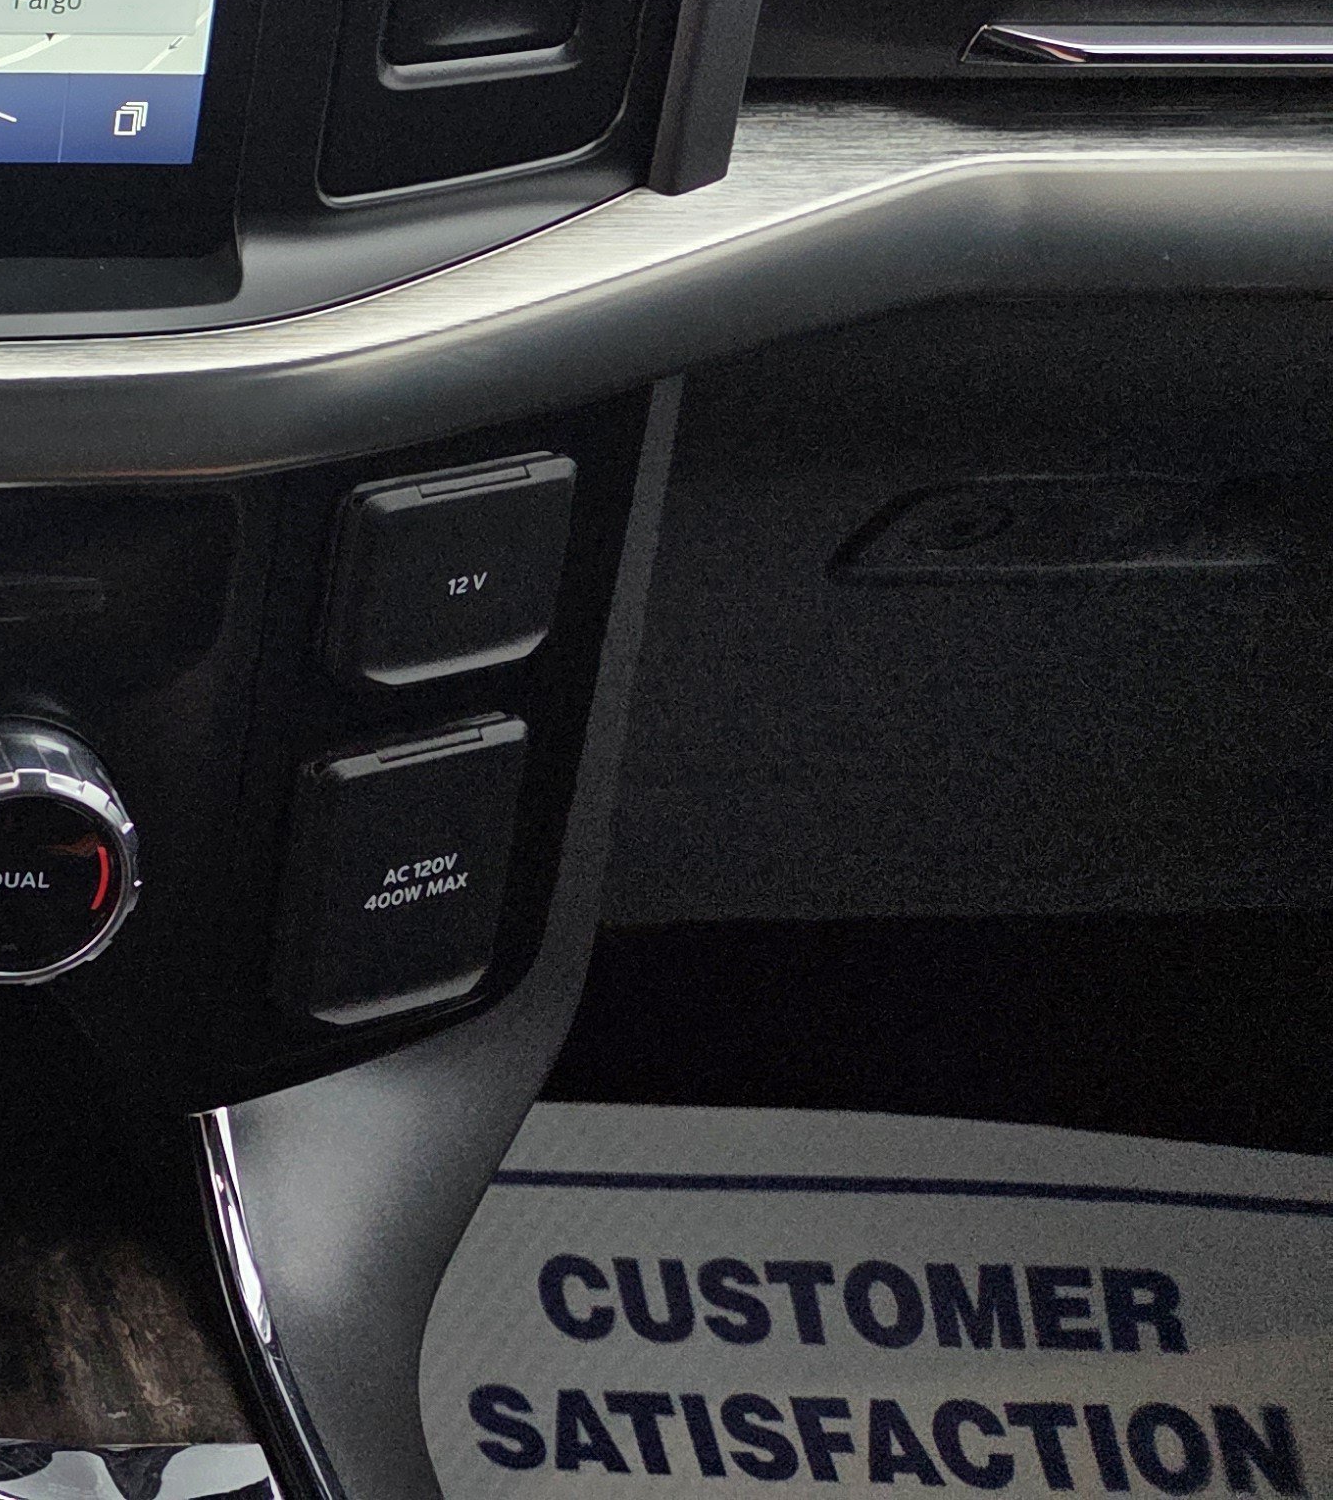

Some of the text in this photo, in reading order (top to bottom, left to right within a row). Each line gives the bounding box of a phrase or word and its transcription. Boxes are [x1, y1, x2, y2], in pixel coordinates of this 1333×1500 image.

[448, 572, 487, 596] 12 V
[383, 853, 458, 886] AC 120V
[364, 873, 468, 912] 400W MAX
[537, 1253, 1190, 1355] CUSTOMER
[467, 1382, 1309, 1499] SATISFACTION
